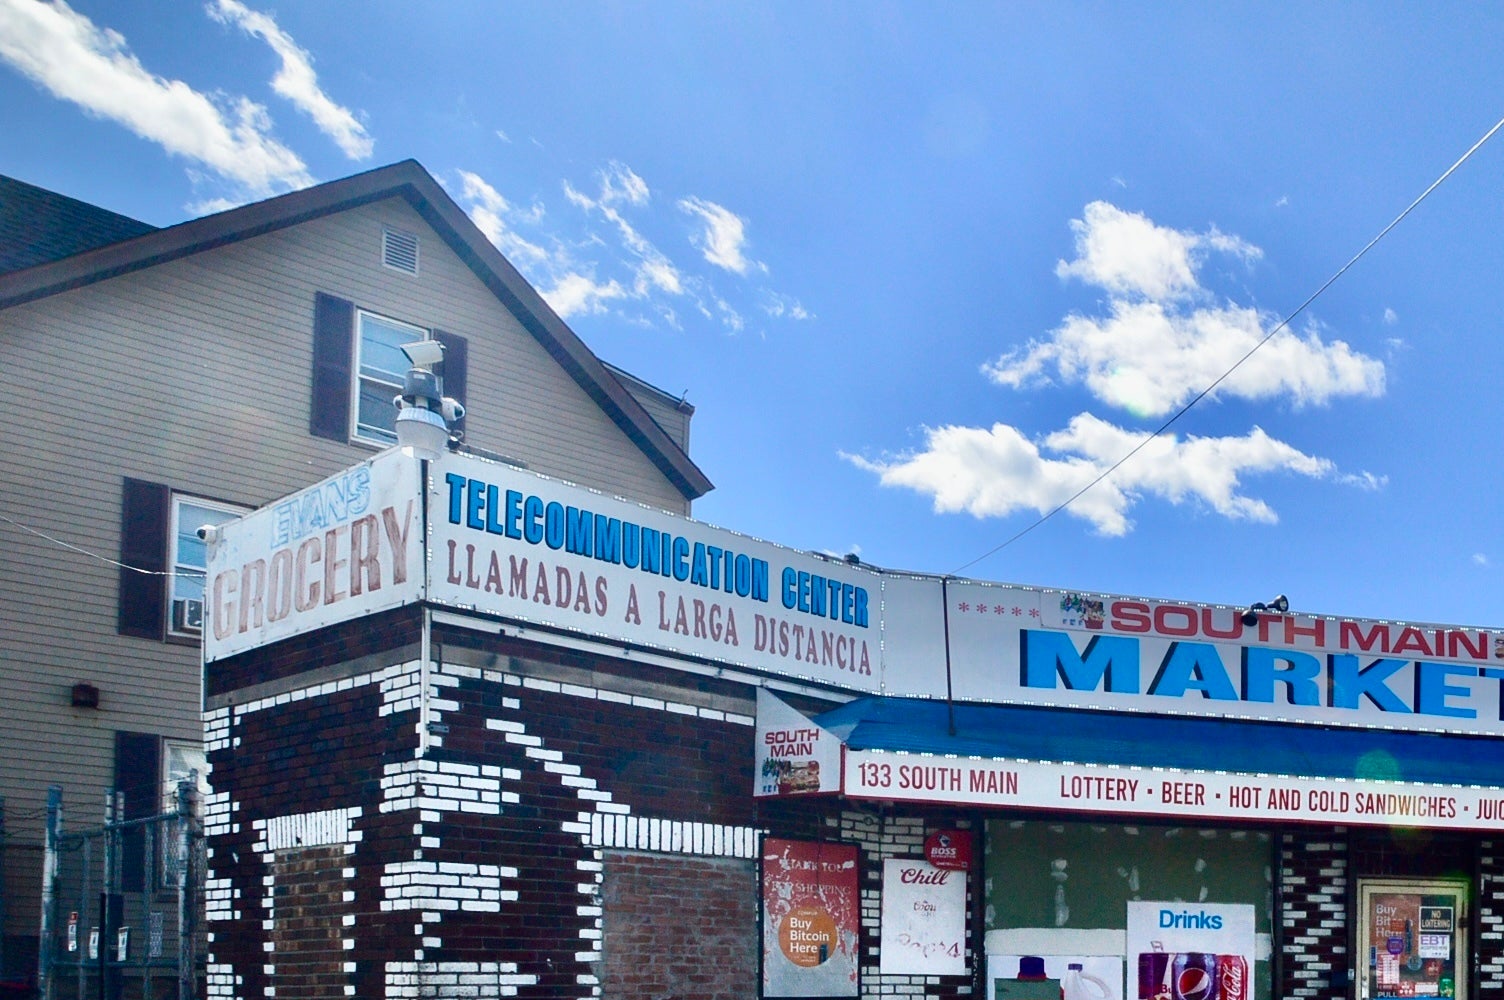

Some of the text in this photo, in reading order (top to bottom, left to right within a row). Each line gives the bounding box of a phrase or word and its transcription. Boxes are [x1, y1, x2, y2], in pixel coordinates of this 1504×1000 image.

[271, 464, 371, 549] EVANS
[446, 472, 869, 628] TELECOMMUNICATION CENTER
[213, 499, 414, 641] GROCERY
[447, 539, 872, 676] LLAMADAS A LARGA DISTANCIA
[1111, 601, 1489, 660] SOUTH MAIN
[765, 728, 820, 744] SOUTH
[770, 742, 813, 758] MAIN
[858, 763, 1019, 795] 133 SOUTH MAIN
[1060, 775, 1139, 801] LOTTERY
[1161, 781, 1205, 806] BEER
[1229, 786, 1262, 809] HOT
[1267, 788, 1301, 811] AND
[1308, 790, 1349, 813] COLD
[1355, 792, 1456, 818] SANDWICHES
[931, 847, 957, 855] BOSS
[900, 867, 951, 885] Chill
[1376, 903, 1397, 917] Buy
[1431, 910, 1442, 918] NO
[790, 917, 812, 931] Buy
[1159, 909, 1223, 930] Drinks
[1421, 919, 1451, 929] LOITERING
[790, 929, 830, 942] Bitcoin
[1420, 935, 1448, 946] EBT
[790, 942, 818, 953] Here
